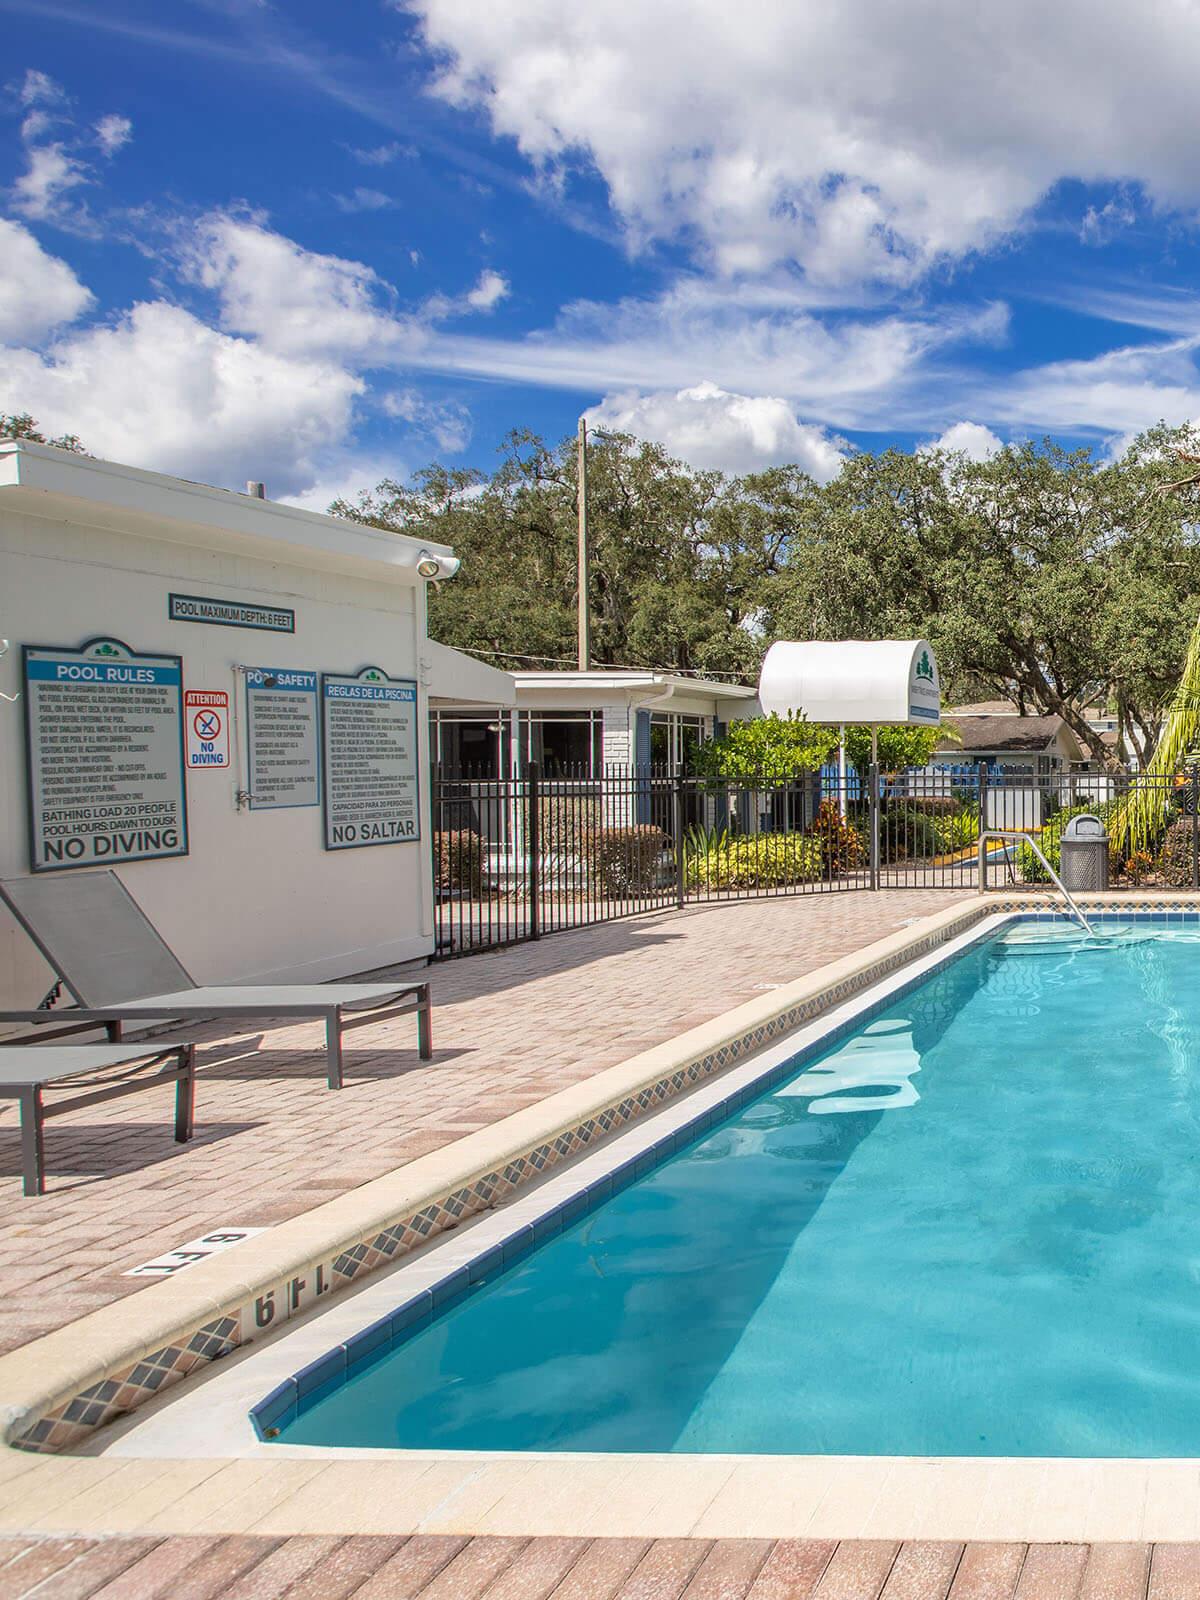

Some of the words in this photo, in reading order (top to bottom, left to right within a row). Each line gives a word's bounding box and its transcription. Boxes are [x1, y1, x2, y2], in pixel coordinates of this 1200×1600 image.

[175, 601, 199, 616] POOL
[200, 605, 240, 620] MAXIMUM
[241, 610, 268, 623] DEPTH:
[268, 614, 273, 624] 6
[274, 615, 290, 626] FEET
[57, 665, 104, 680] POOL
[107, 668, 155, 682] RULES
[278, 674, 315, 687] SAFETY
[188, 694, 226, 705] ATTENTION
[328, 686, 360, 698] REGLAS
[361, 688, 372, 698] DE
[374, 688, 384, 698] LA
[385, 689, 413, 700] PISCINA
[200, 742, 214, 752] NO
[192, 754, 224, 764] DIVING
[42, 808, 92, 822] BATHING
[94, 807, 122, 818] LOAD
[124, 806, 136, 816] 20
[138, 803, 176, 814] PEOPLE
[365, 801, 380, 809] PARA
[43, 825, 72, 836] POOL
[73, 822, 109, 834] HOURS:
[110, 818, 138, 830] DAWN
[138, 817, 151, 828] TO
[152, 816, 176, 826] DUSK
[332, 824, 356, 843] NO
[360, 820, 415, 840] SALTAR
[44, 838, 86, 862] NO
[94, 829, 178, 856] DIVING
[256, 1290, 274, 1328] 6
